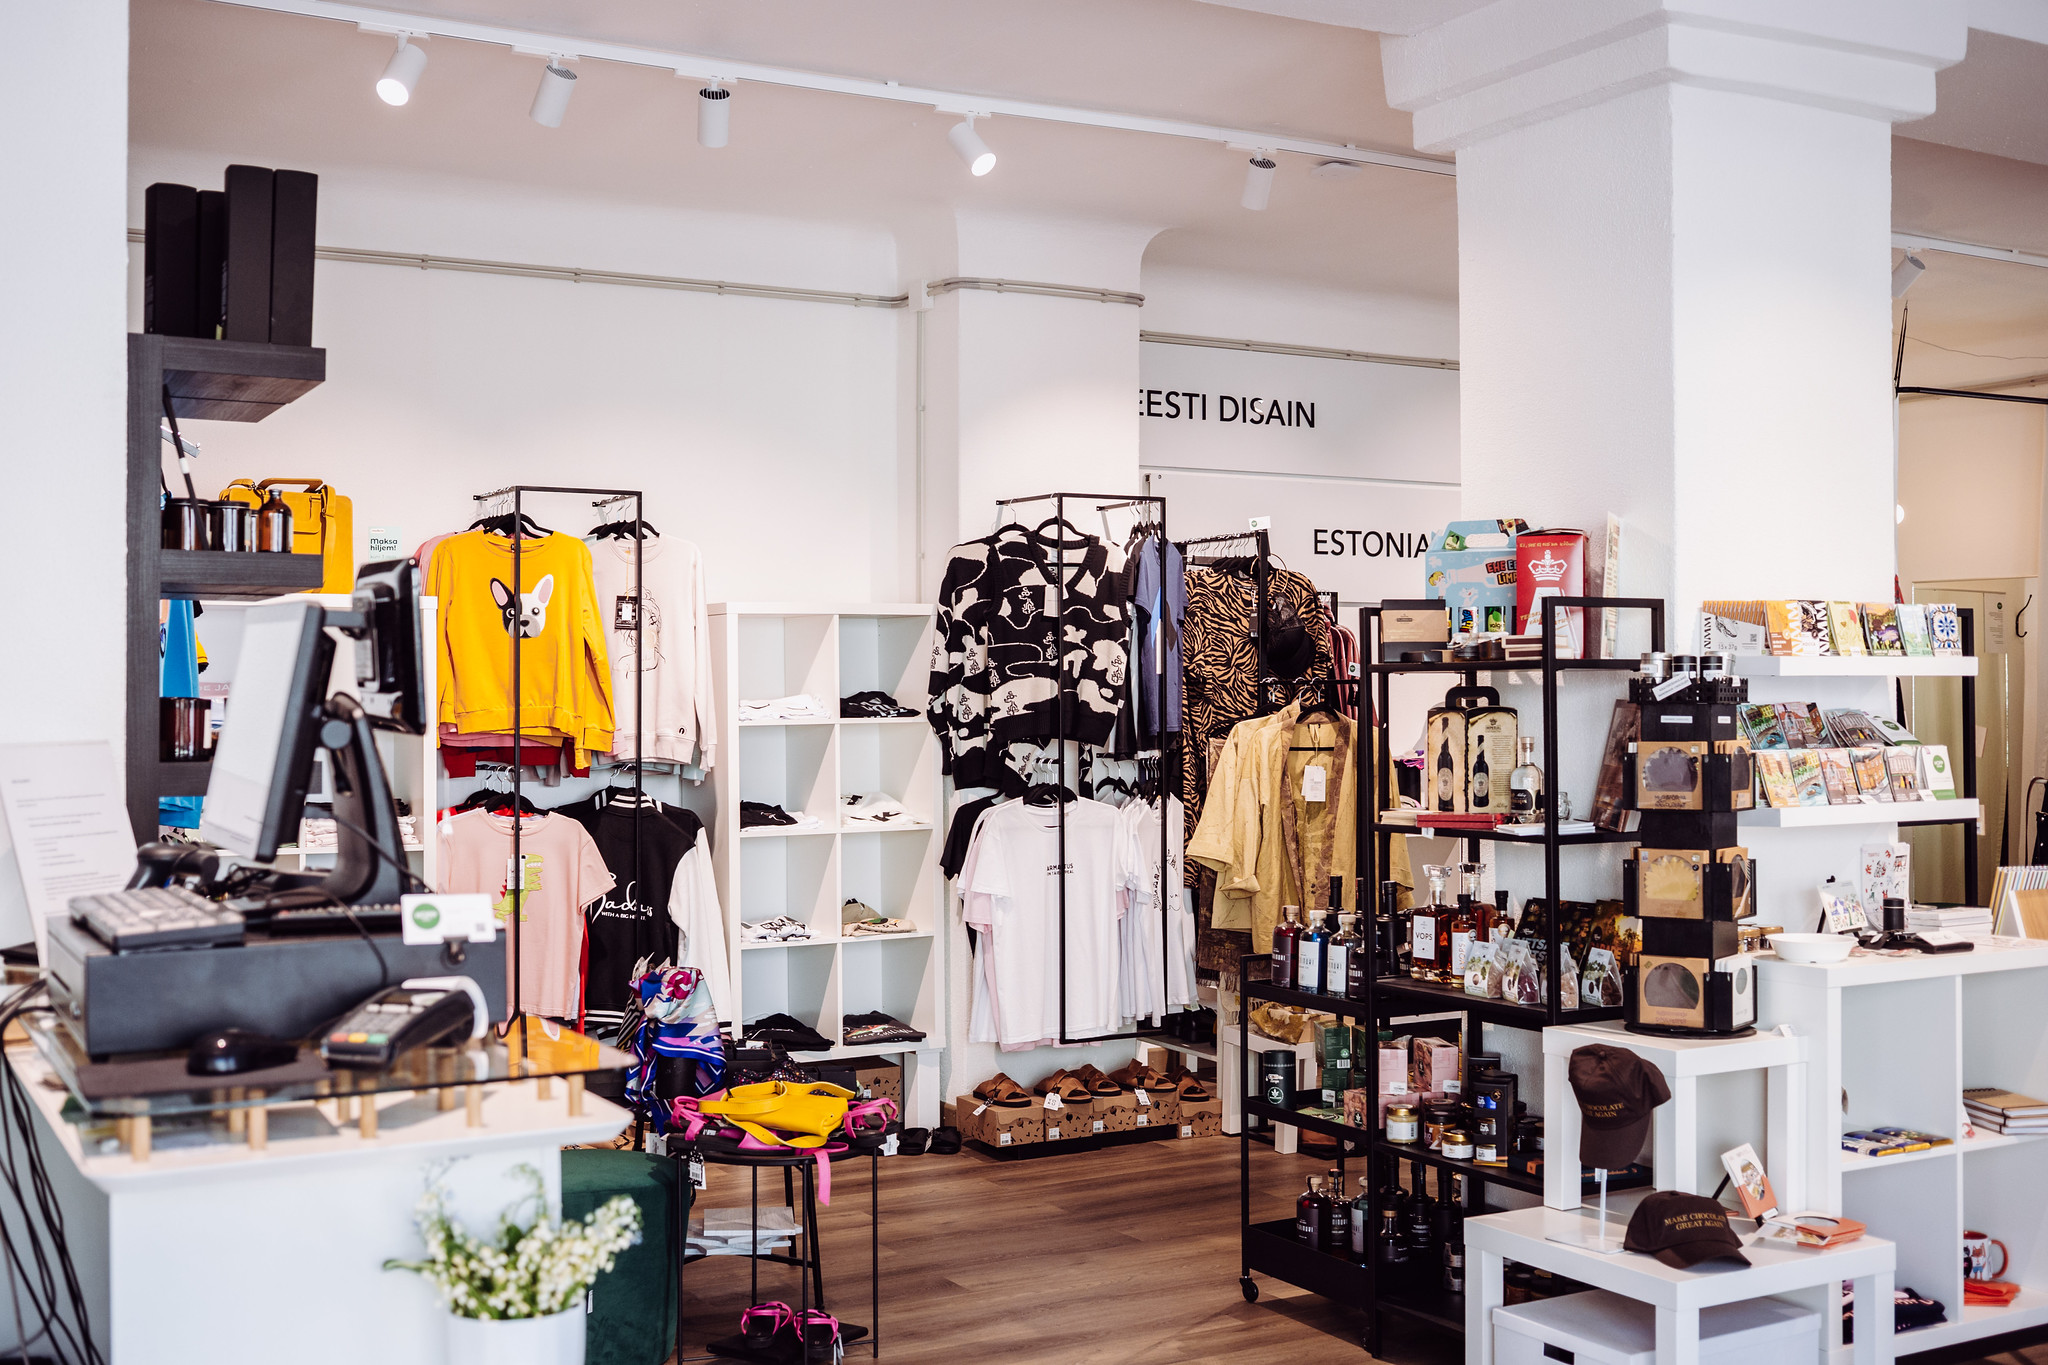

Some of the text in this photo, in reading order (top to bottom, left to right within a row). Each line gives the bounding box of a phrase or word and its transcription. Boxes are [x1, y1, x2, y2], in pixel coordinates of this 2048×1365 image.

[1219, 395, 1315, 428] DISAIN
[1313, 529, 1429, 558] ESTONIA
[1485, 560, 1506, 574] EHE
[1415, 932, 1433, 941] VOPS
[1664, 1213, 1689, 1226] MAKE
[1675, 1219, 1724, 1231] GREAT AGAIN
